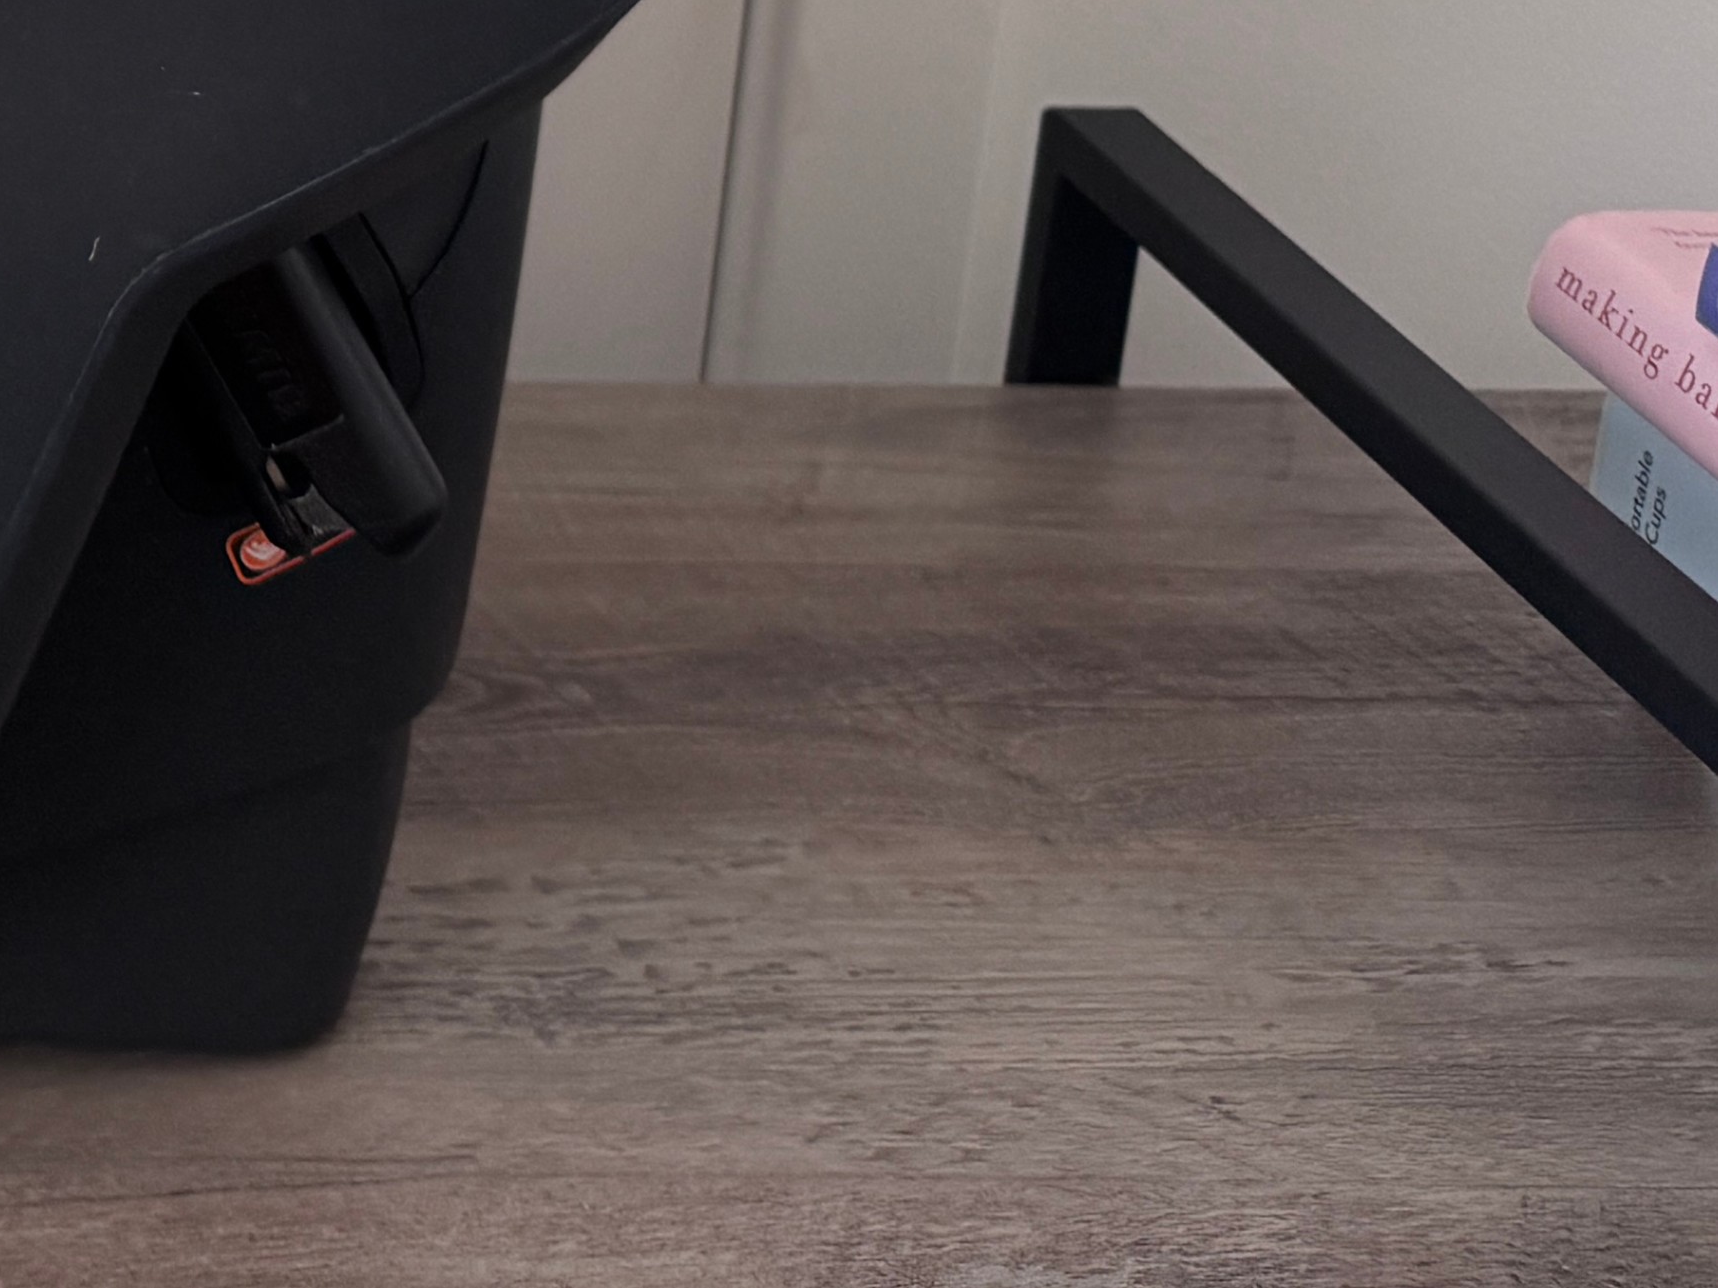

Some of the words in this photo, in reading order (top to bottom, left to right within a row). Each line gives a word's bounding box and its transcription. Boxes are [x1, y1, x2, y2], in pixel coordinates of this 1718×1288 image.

[1555, 265, 1670, 381] making
[1674, 353, 1718, 421] ba
[1630, 449, 1654, 532] ortable
[1644, 485, 1667, 546] Cups
